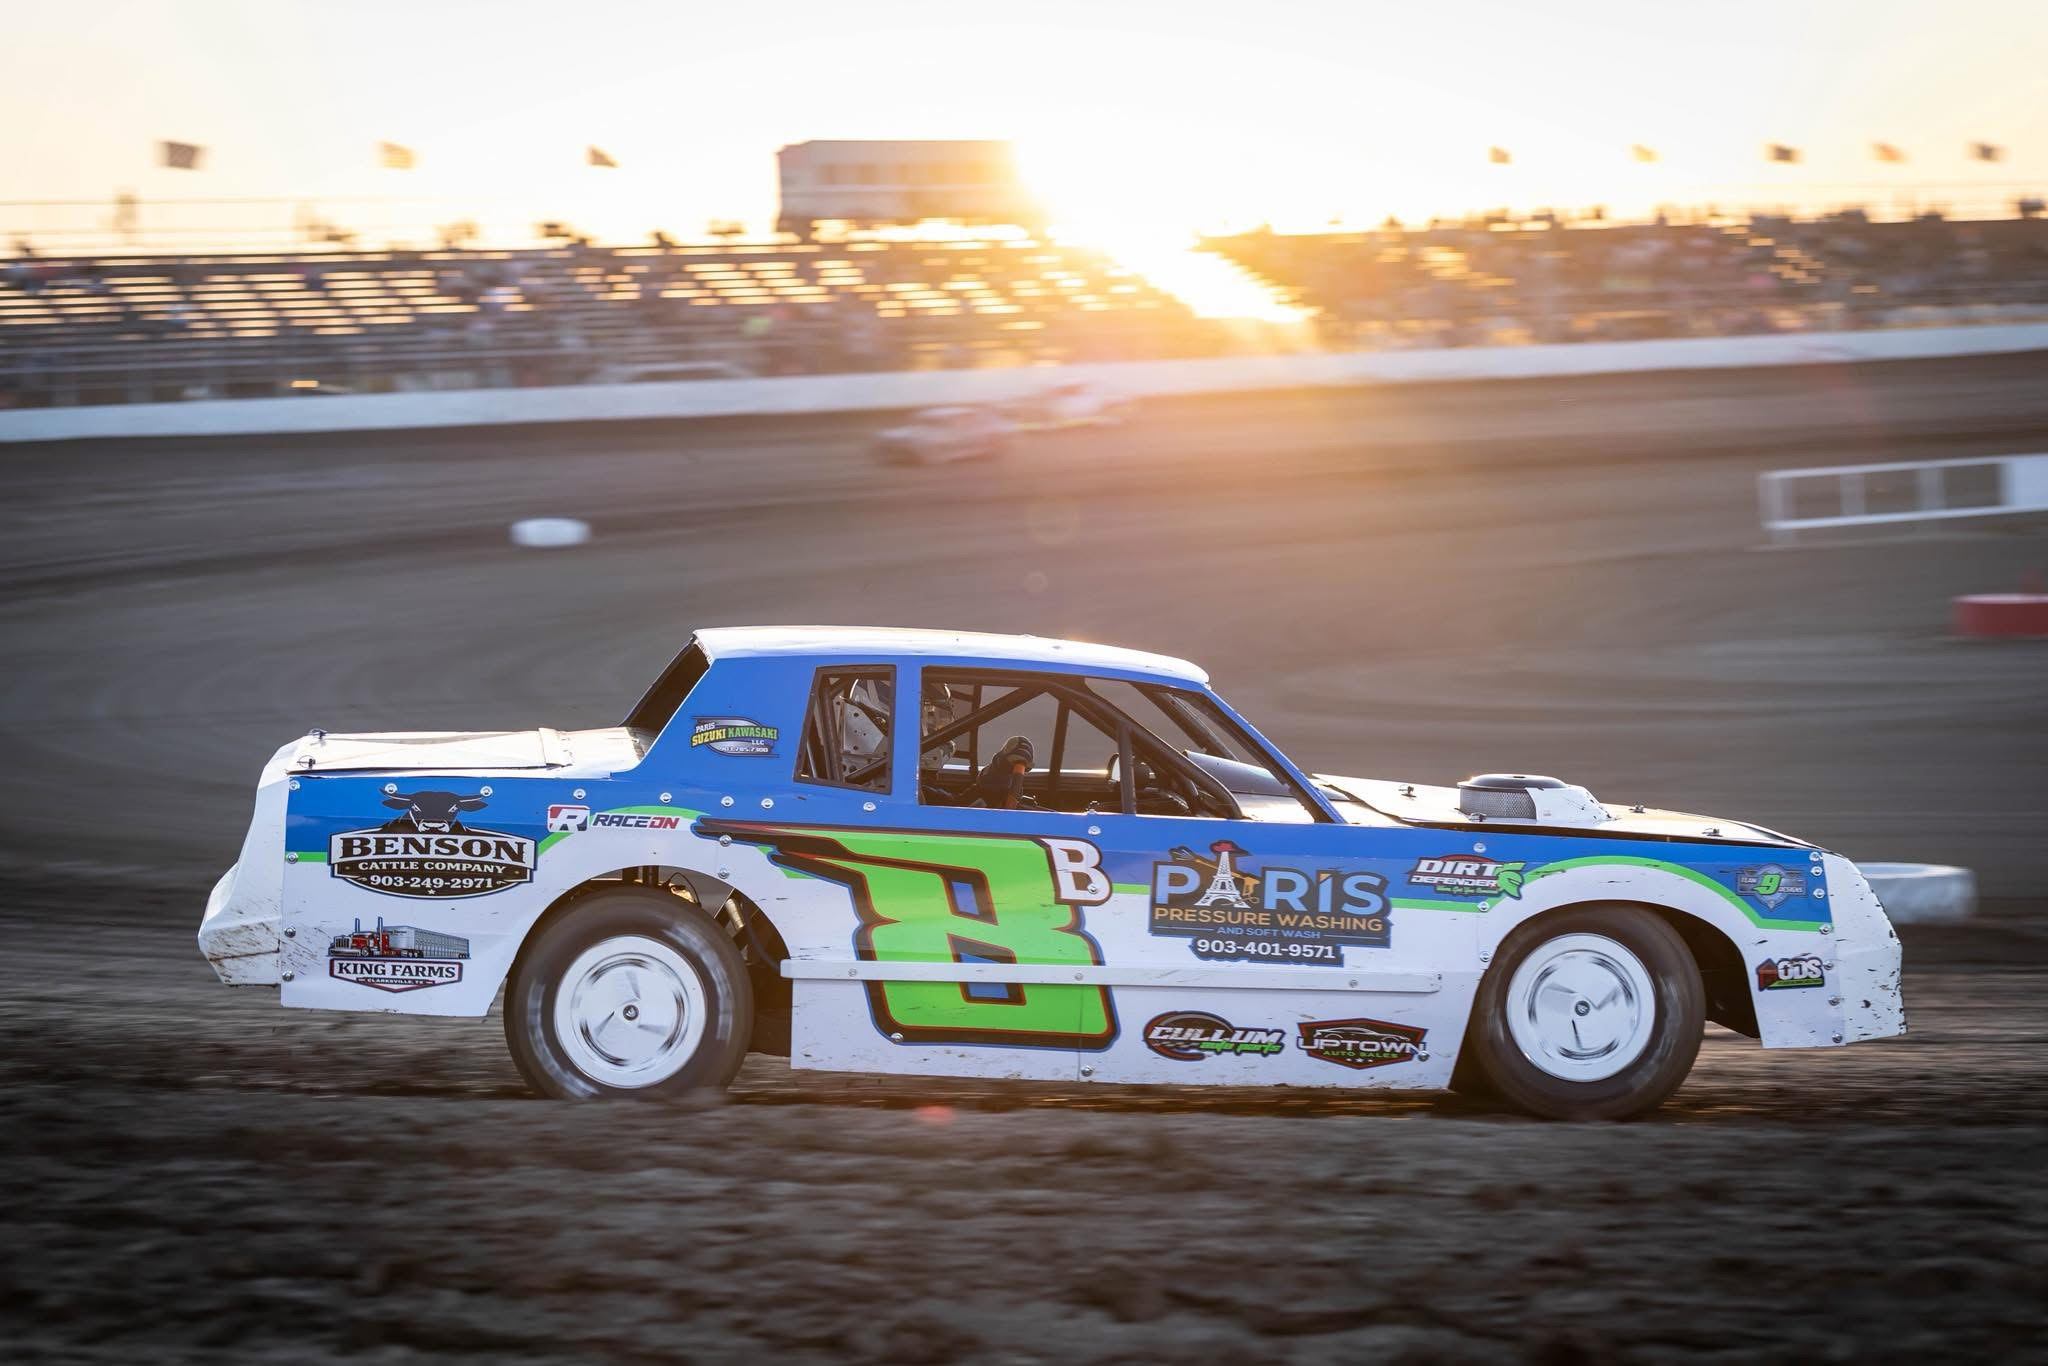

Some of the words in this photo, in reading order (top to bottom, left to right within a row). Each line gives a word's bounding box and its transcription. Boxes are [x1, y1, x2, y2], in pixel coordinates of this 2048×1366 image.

[691, 728, 727, 747] SUZUKI
[727, 727, 778, 740] KAWASAKI
[695, 722, 716, 734] PARIS
[339, 836, 526, 863] BENSON
[358, 861, 419, 871] CATTLE
[423, 861, 507, 874] COMPANY
[1416, 859, 1503, 877] DIRT
[370, 875, 493, 889] 903-249-2971
[1155, 851, 1383, 915] PARIS
[1411, 875, 1497, 887] DEFENDER
[1753, 873, 1781, 895] 9
[1153, 907, 1271, 926] PRESSURE
[1276, 912, 1384, 932] WASHING
[765, 828, 1115, 1048] 8
[1042, 838, 1110, 900] B
[1216, 926, 1244, 935] AND
[1246, 927, 1279, 937] SOFT
[1280, 929, 1321, 939] WASH
[1196, 938, 1337, 959] 903-401-9571
[338, 962, 386, 976] KING
[391, 964, 456, 979] FARMS
[1148, 1026, 1282, 1044] CULLUM
[1297, 1037, 1426, 1056] UPTOWN
[1359, 1051, 1399, 1059] SALES
